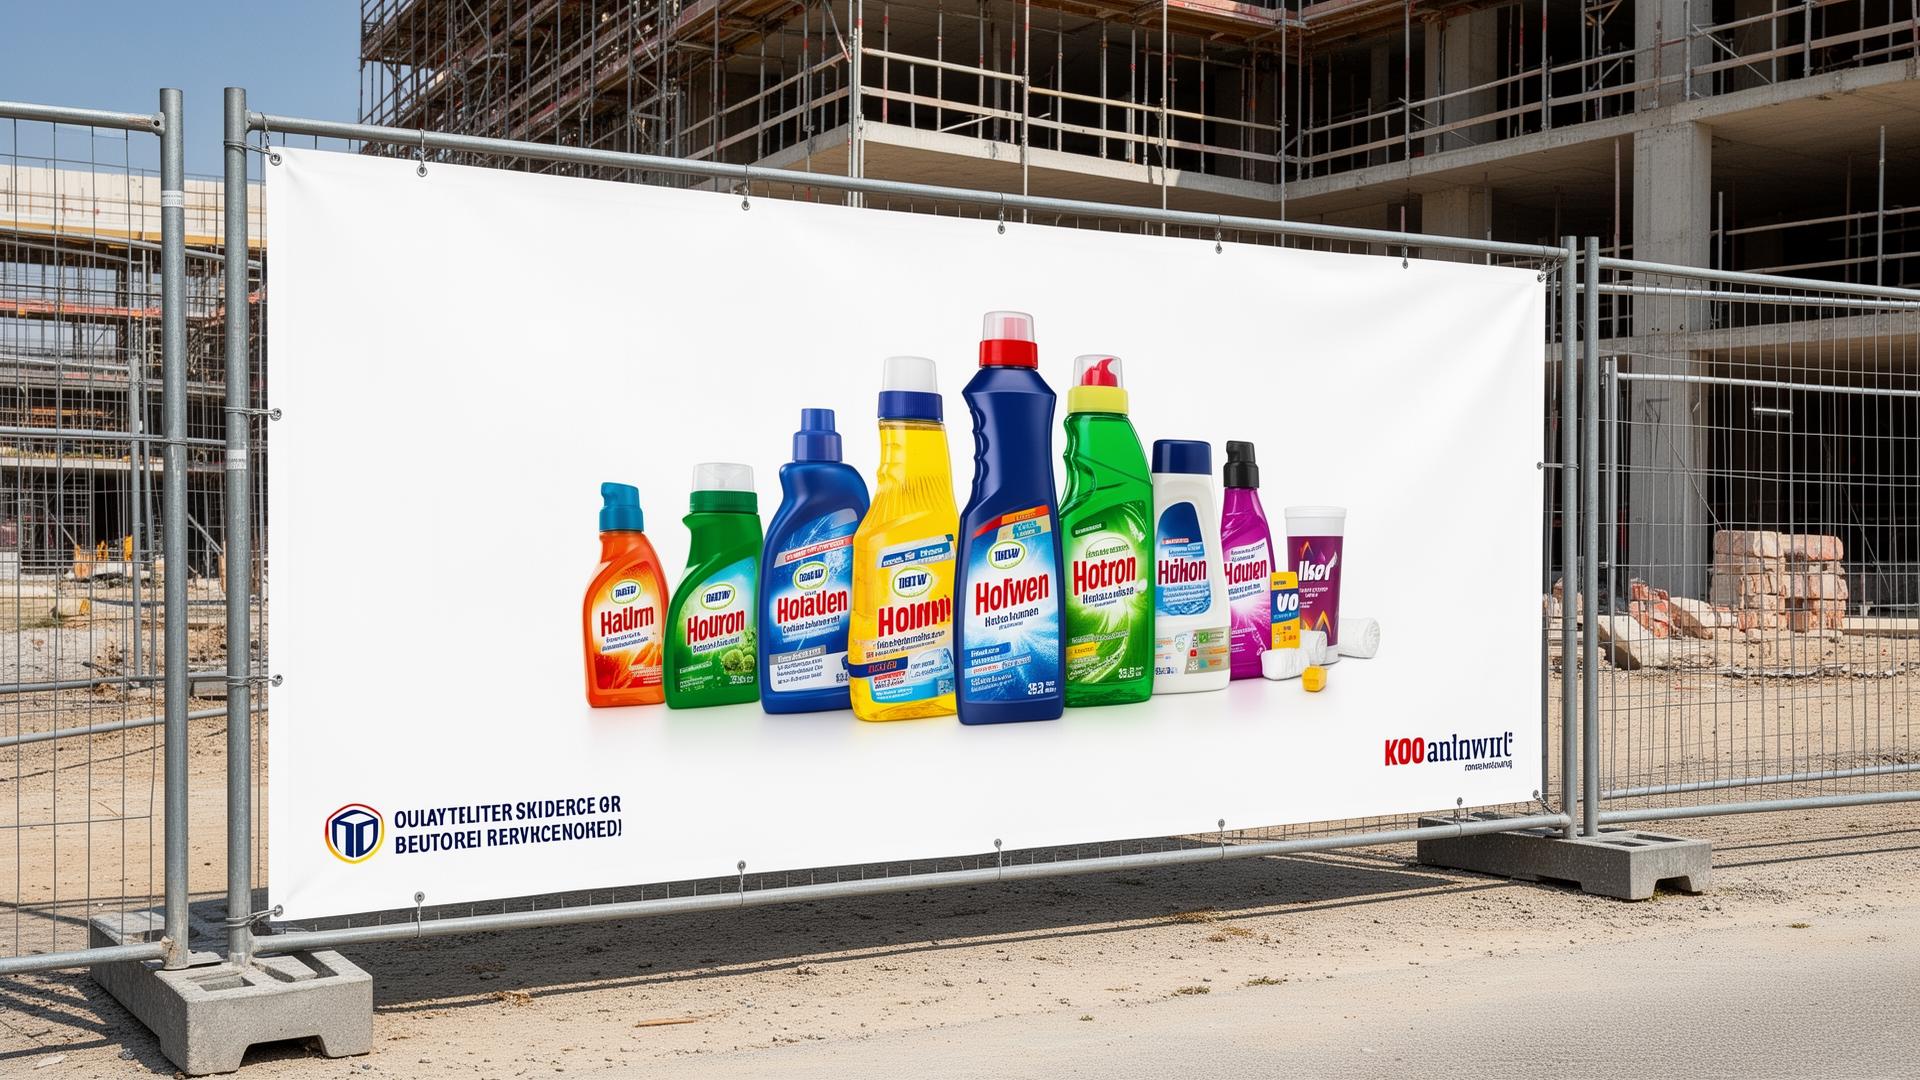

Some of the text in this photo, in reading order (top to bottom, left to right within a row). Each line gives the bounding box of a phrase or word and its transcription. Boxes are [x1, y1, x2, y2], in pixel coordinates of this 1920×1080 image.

[1073, 557, 1136, 596] Hotron
[687, 610, 745, 645] Houron
[516, 797, 596, 820] SKIDERCE
[396, 830, 481, 854] BEUTOREI
